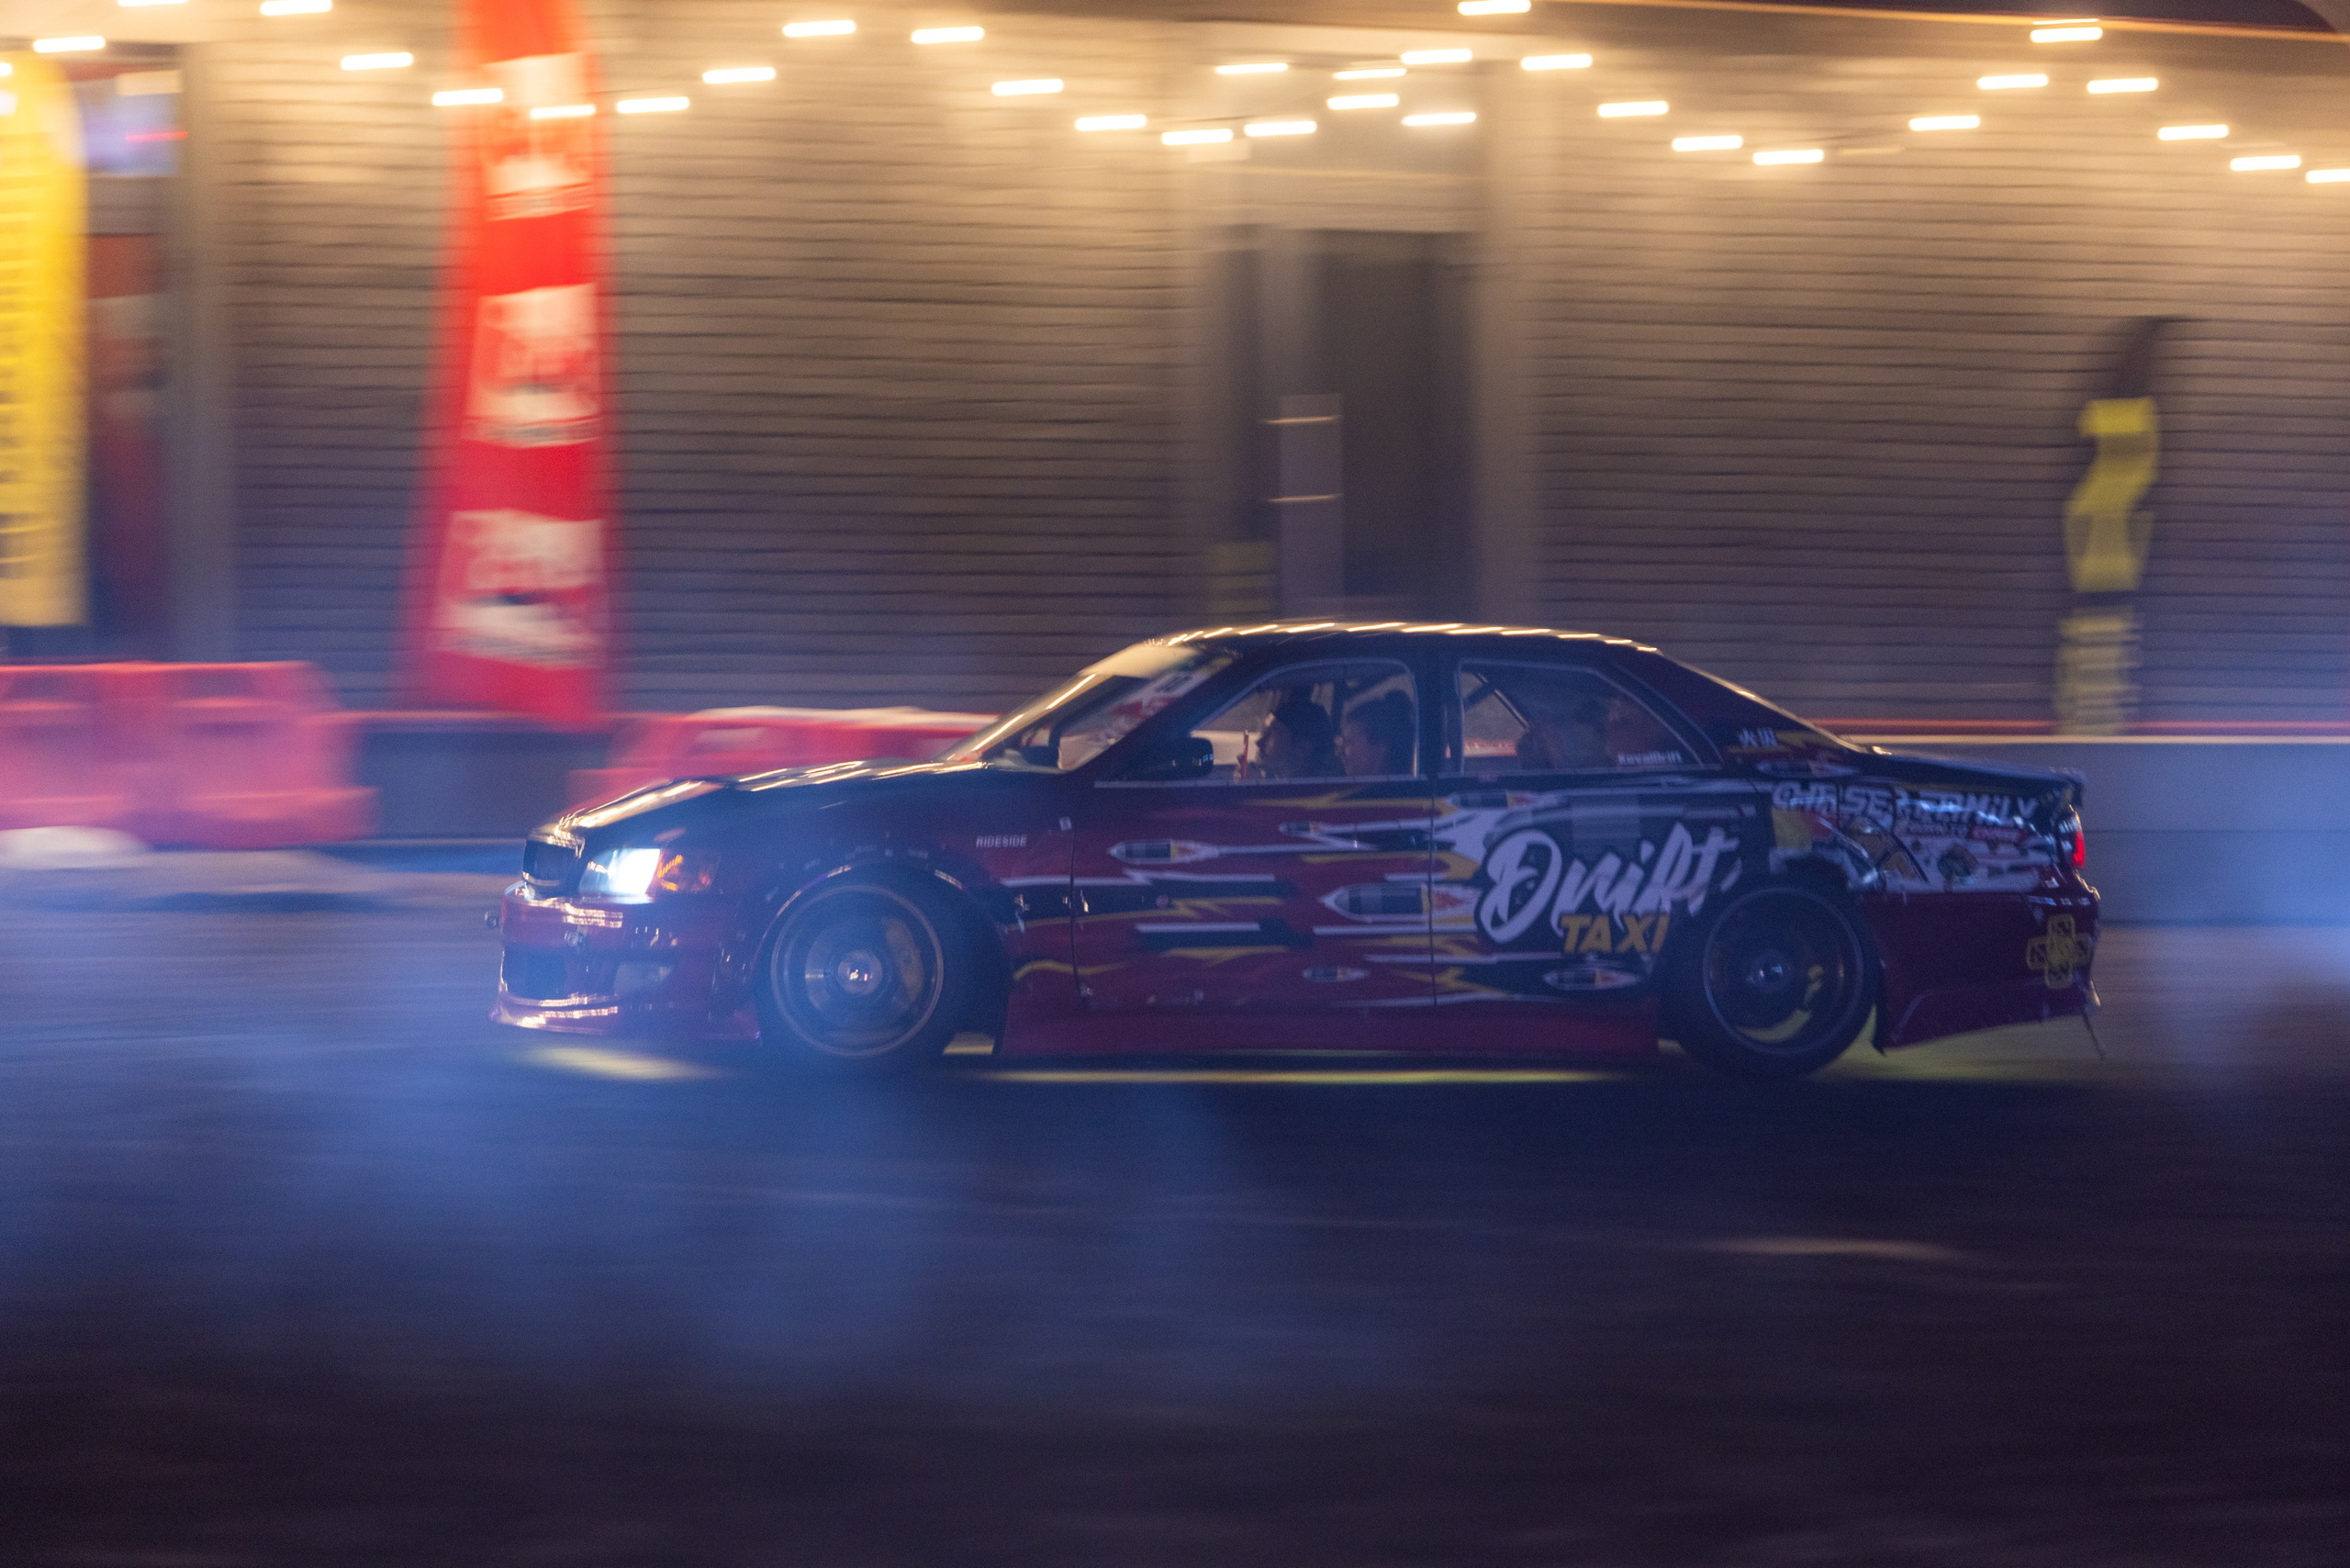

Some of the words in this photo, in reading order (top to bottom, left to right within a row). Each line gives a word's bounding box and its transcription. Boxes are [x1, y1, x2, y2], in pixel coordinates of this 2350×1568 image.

[976, 834, 1027, 848] RIDESIDE
[1480, 822, 1741, 944] Drift
[1560, 914, 1670, 954] TAXI
